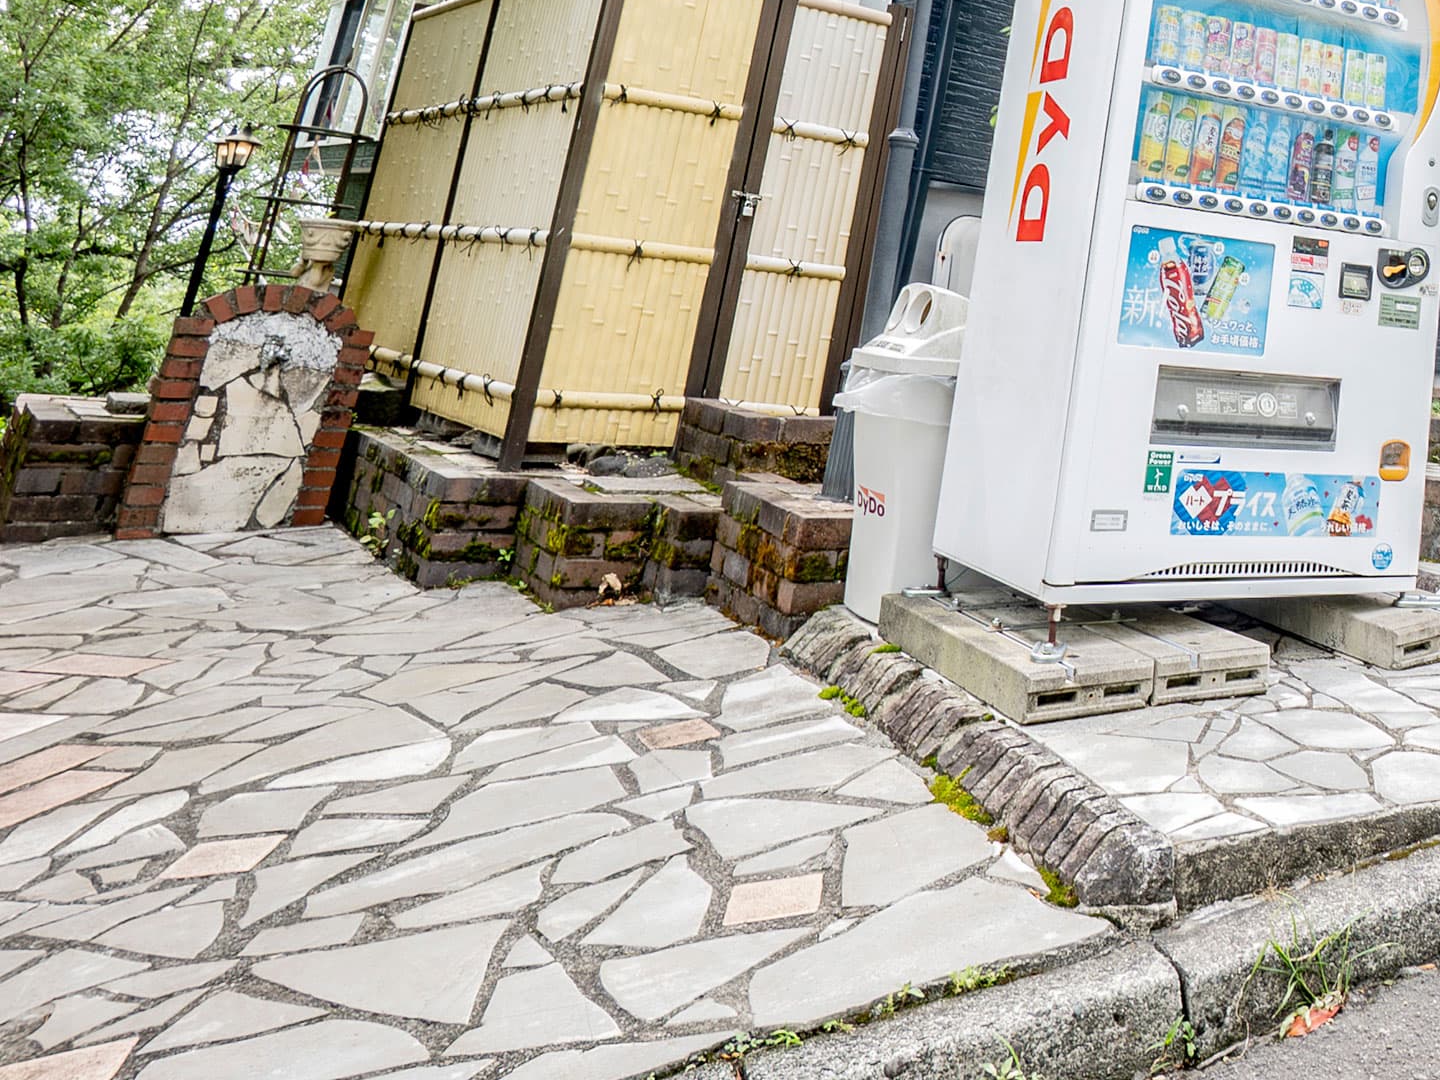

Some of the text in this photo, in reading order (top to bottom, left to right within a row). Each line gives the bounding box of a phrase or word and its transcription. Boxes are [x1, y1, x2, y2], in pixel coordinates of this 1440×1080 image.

[1149, 458, 1172, 466] Power
[857, 490, 886, 518] DyDo
[1185, 489, 1277, 518] ハート プライス
